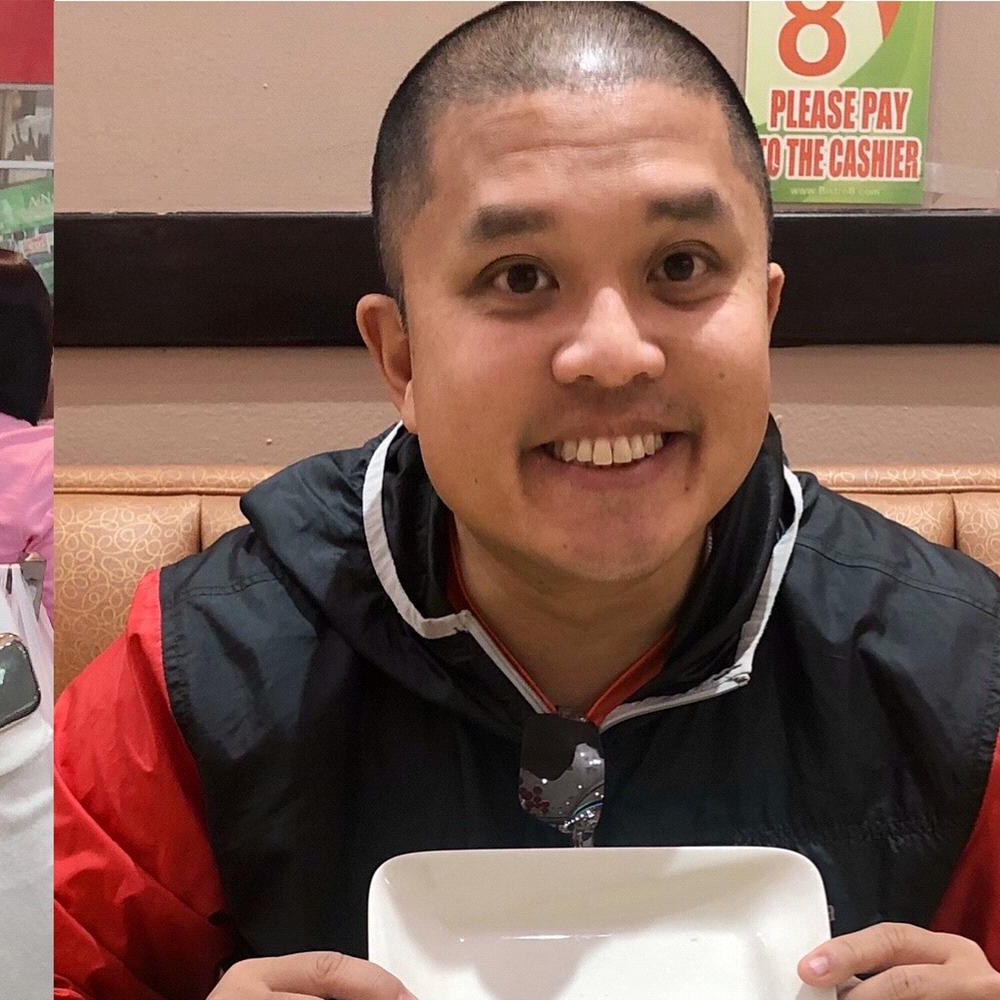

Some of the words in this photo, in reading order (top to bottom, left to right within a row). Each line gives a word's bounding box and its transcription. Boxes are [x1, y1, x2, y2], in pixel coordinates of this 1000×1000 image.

[778, 1, 847, 77] 8
[770, 90, 856, 130] PLEASE
[861, 91, 909, 130] PAY
[786, 138, 824, 178] THE
[828, 139, 921, 179] CASHIER
